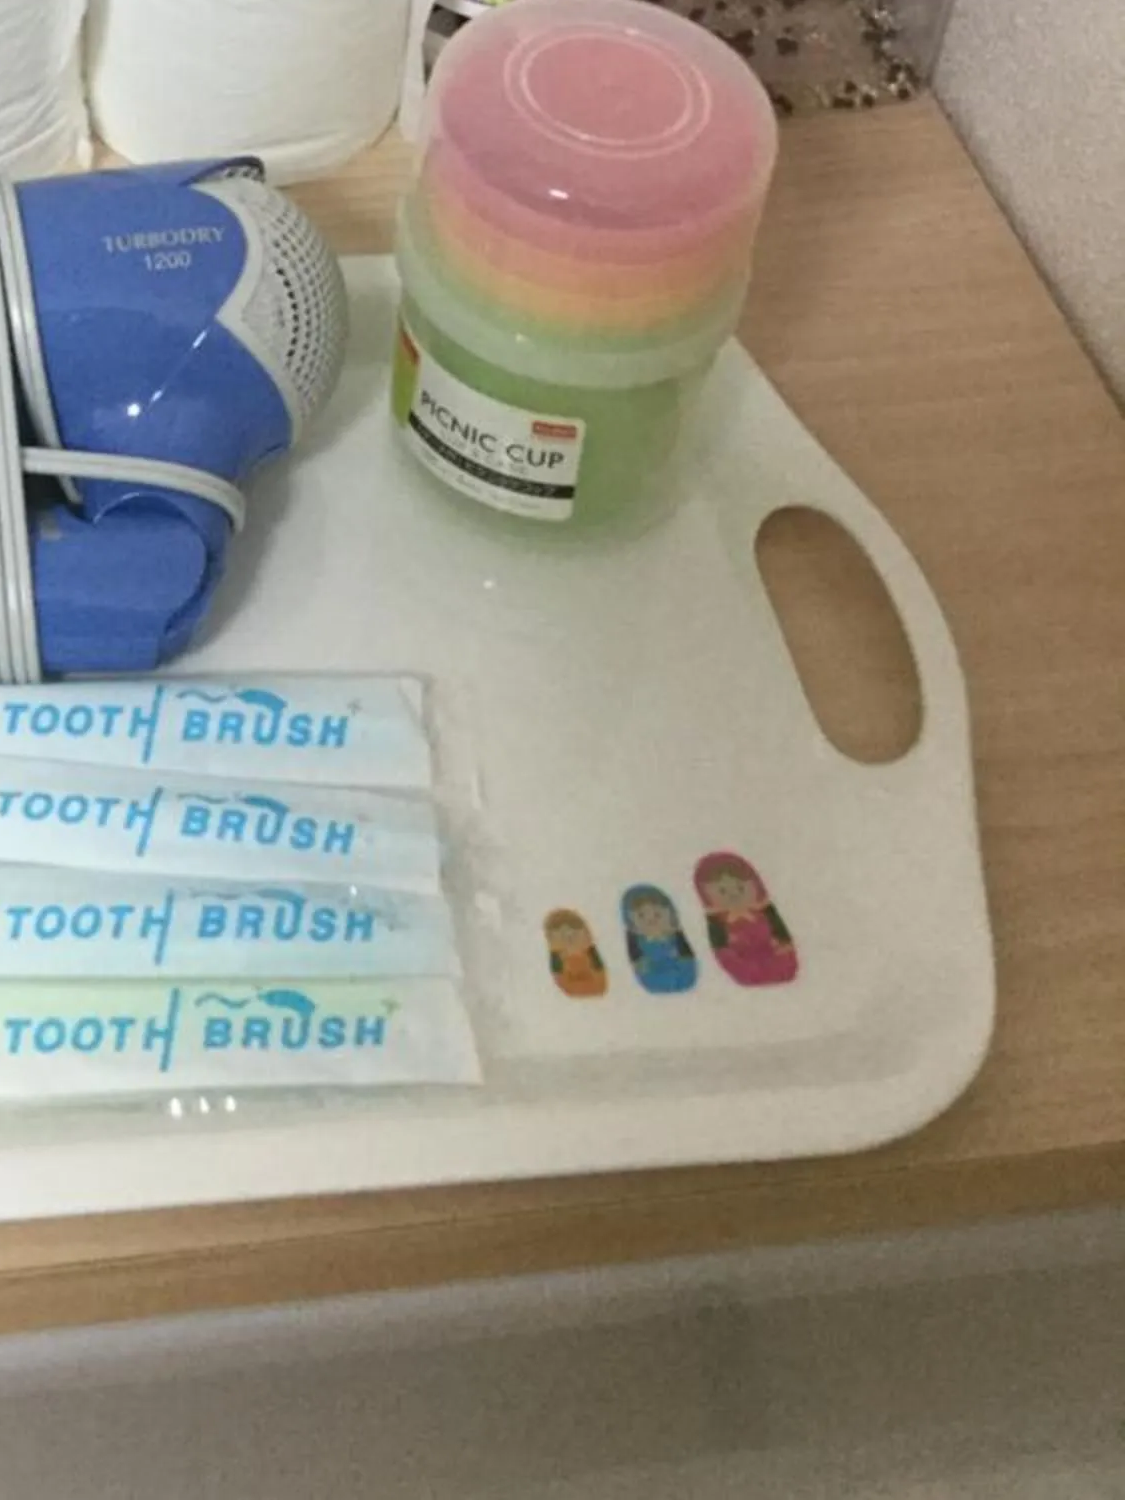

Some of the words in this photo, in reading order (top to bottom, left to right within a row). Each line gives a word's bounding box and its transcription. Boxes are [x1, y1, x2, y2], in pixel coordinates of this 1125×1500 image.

[102, 227, 225, 253] TURBODRY
[145, 251, 191, 271] 1200
[421, 390, 497, 453] PICNIC
[506, 444, 565, 469] CUP
[2, 684, 164, 764] TOOTH
[182, 689, 349, 748] BRUSH
[179, 795, 356, 855] BRUSH
[5, 889, 175, 966] TOOTH
[197, 890, 376, 942] BRUSH
[3, 988, 181, 1073] TOOTH
[203, 990, 387, 1050] BRUSH
